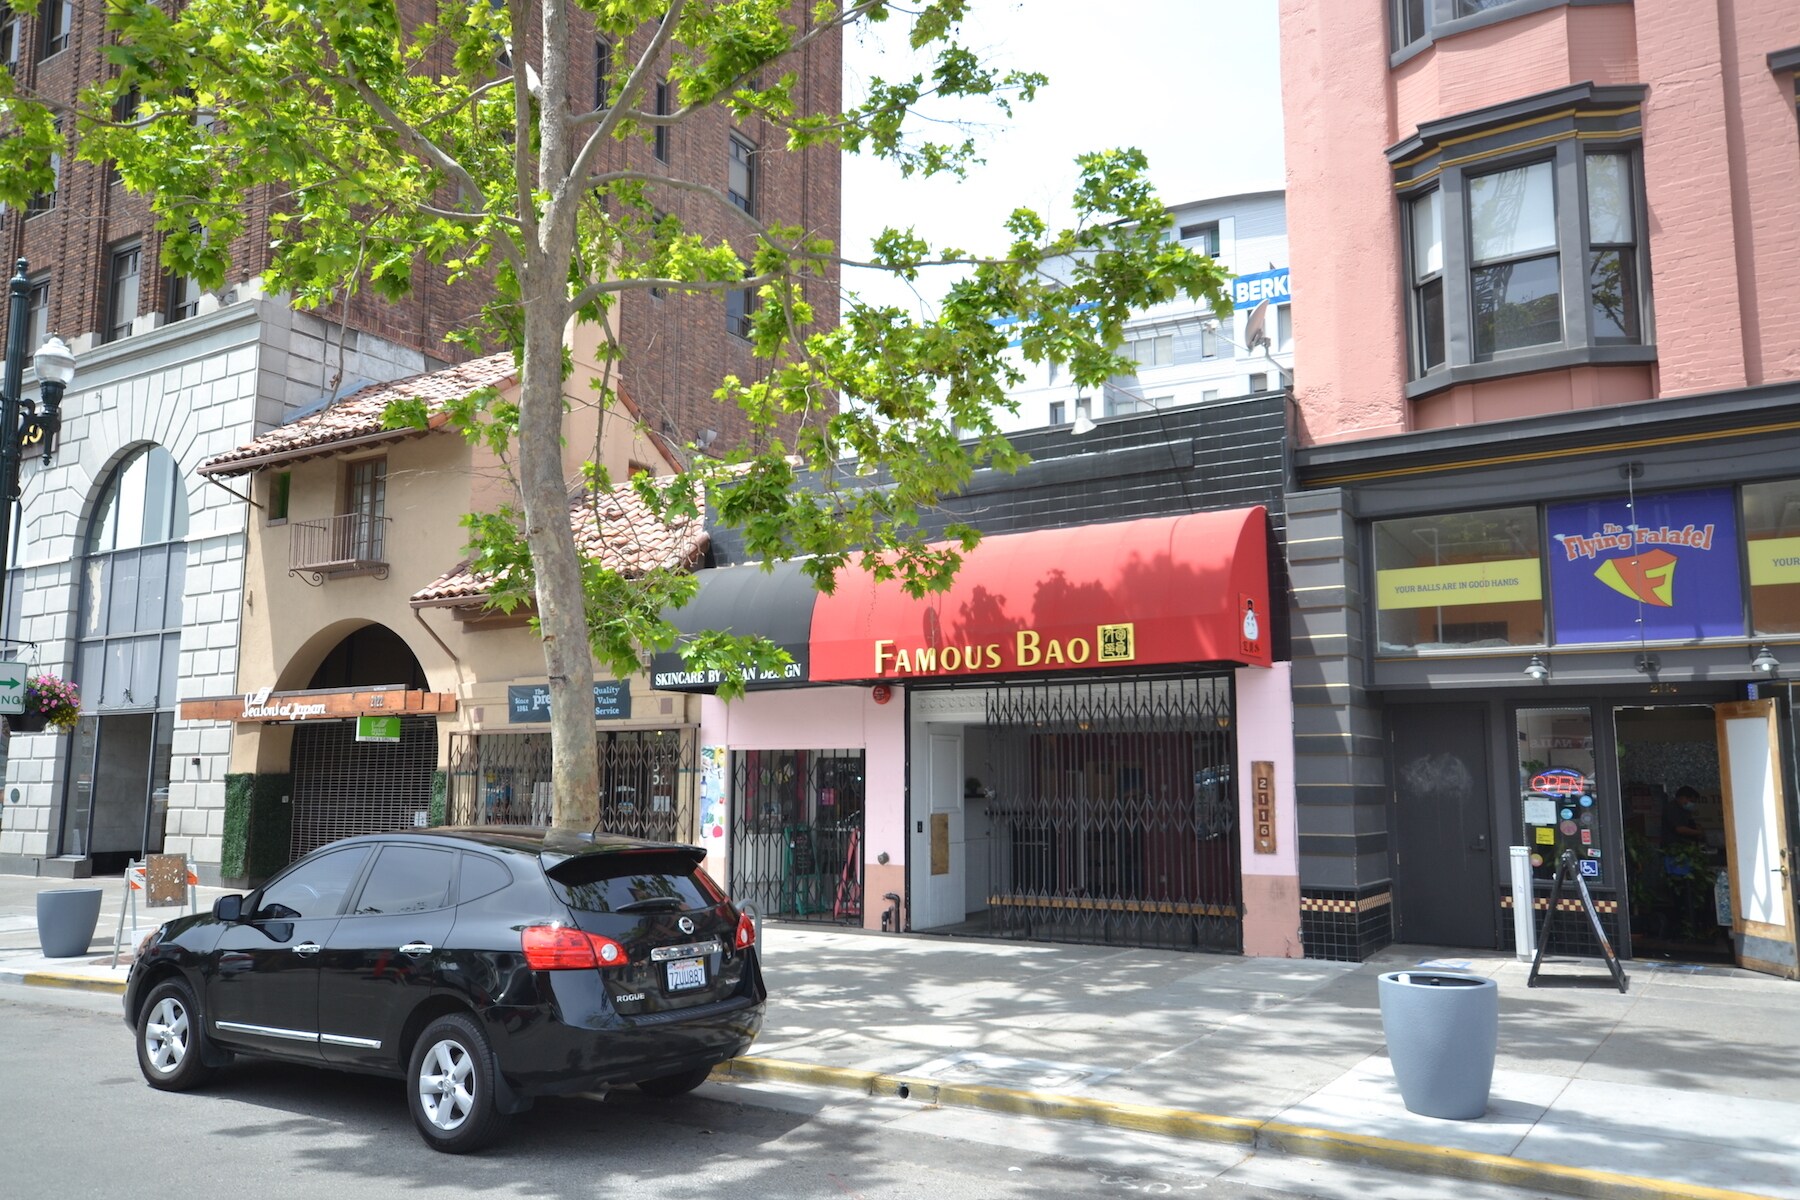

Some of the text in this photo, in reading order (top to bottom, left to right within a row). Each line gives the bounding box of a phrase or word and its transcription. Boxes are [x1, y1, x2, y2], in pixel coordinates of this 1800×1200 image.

[1236, 274, 1290, 303] BERK
[1603, 523, 1623, 534] The
[1562, 524, 1715, 562] Flying Falafel
[1772, 557, 1800, 567] YOUR
[1394, 578, 1519, 594] YOUR BALLS ARE IN GOOD HANDS
[655, 671, 704, 686] SKINCARE
[708, 670, 721, 682] BY
[534, 688, 545, 696] The
[593, 686, 620, 695] Quality
[532, 693, 552, 710] pre
[597, 697, 617, 705] Value
[290, 703, 326, 720] Japan
[595, 706, 620, 715] Service
[1532, 775, 1585, 794] OPEN
[1259, 779, 1269, 836] 2116
[616, 992, 645, 1003] ROGUE
